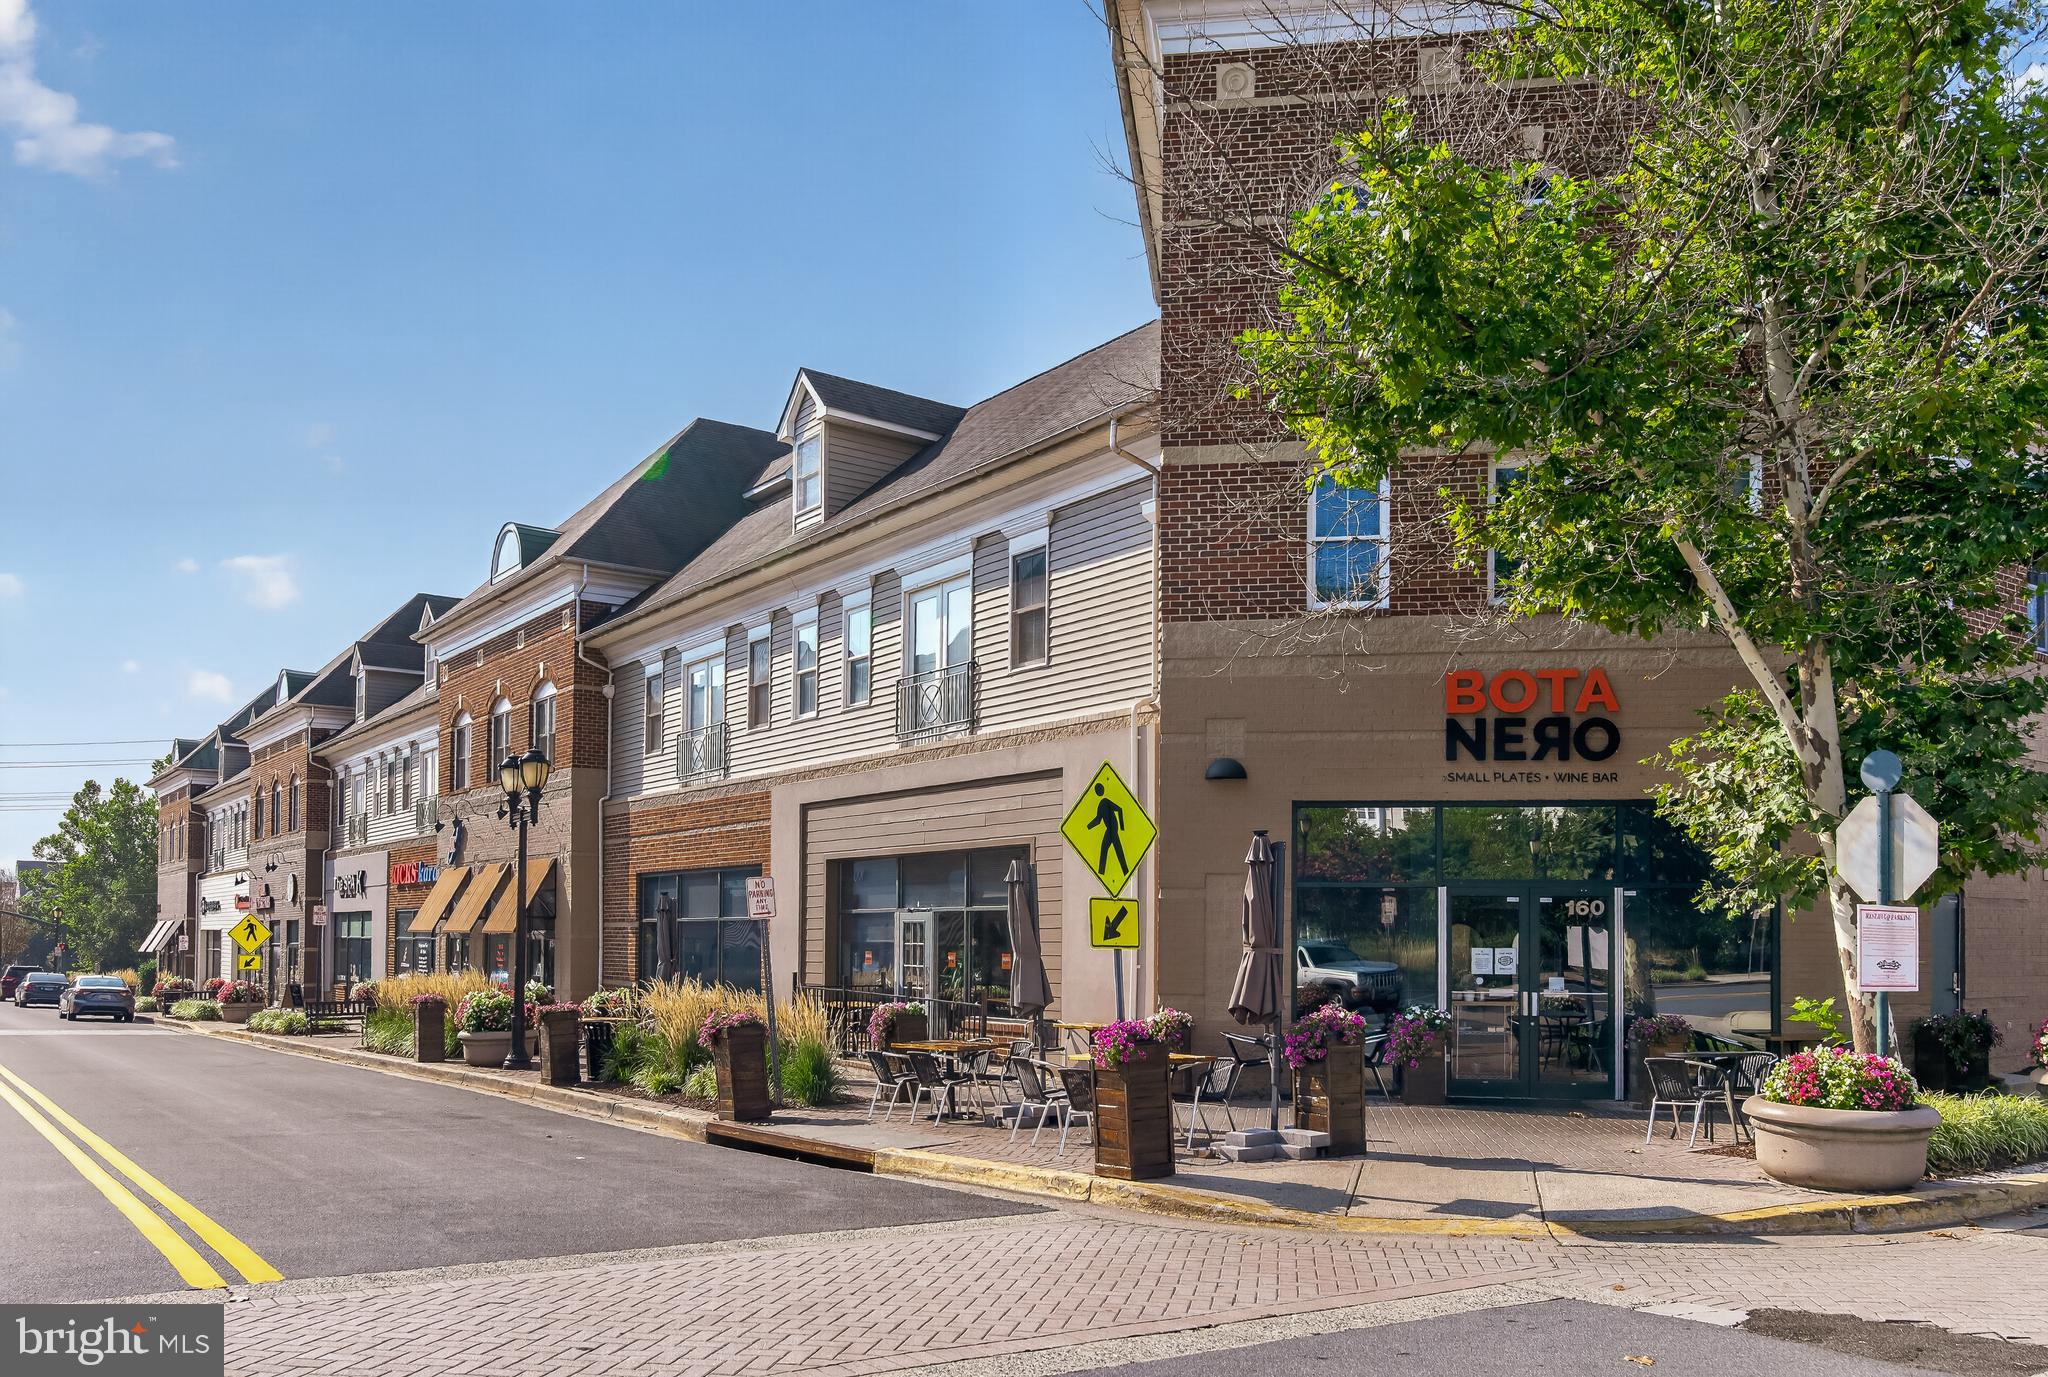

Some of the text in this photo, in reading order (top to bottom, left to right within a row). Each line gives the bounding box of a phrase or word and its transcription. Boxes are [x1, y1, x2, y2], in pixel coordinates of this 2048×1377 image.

[1446, 668, 1620, 714] BOTA
[1447, 772, 1618, 783] SMALL PLATES WINE BAR
[754, 880, 765, 889] NO
[748, 889, 773, 898] PARKING
[1565, 899, 1605, 916] 160
